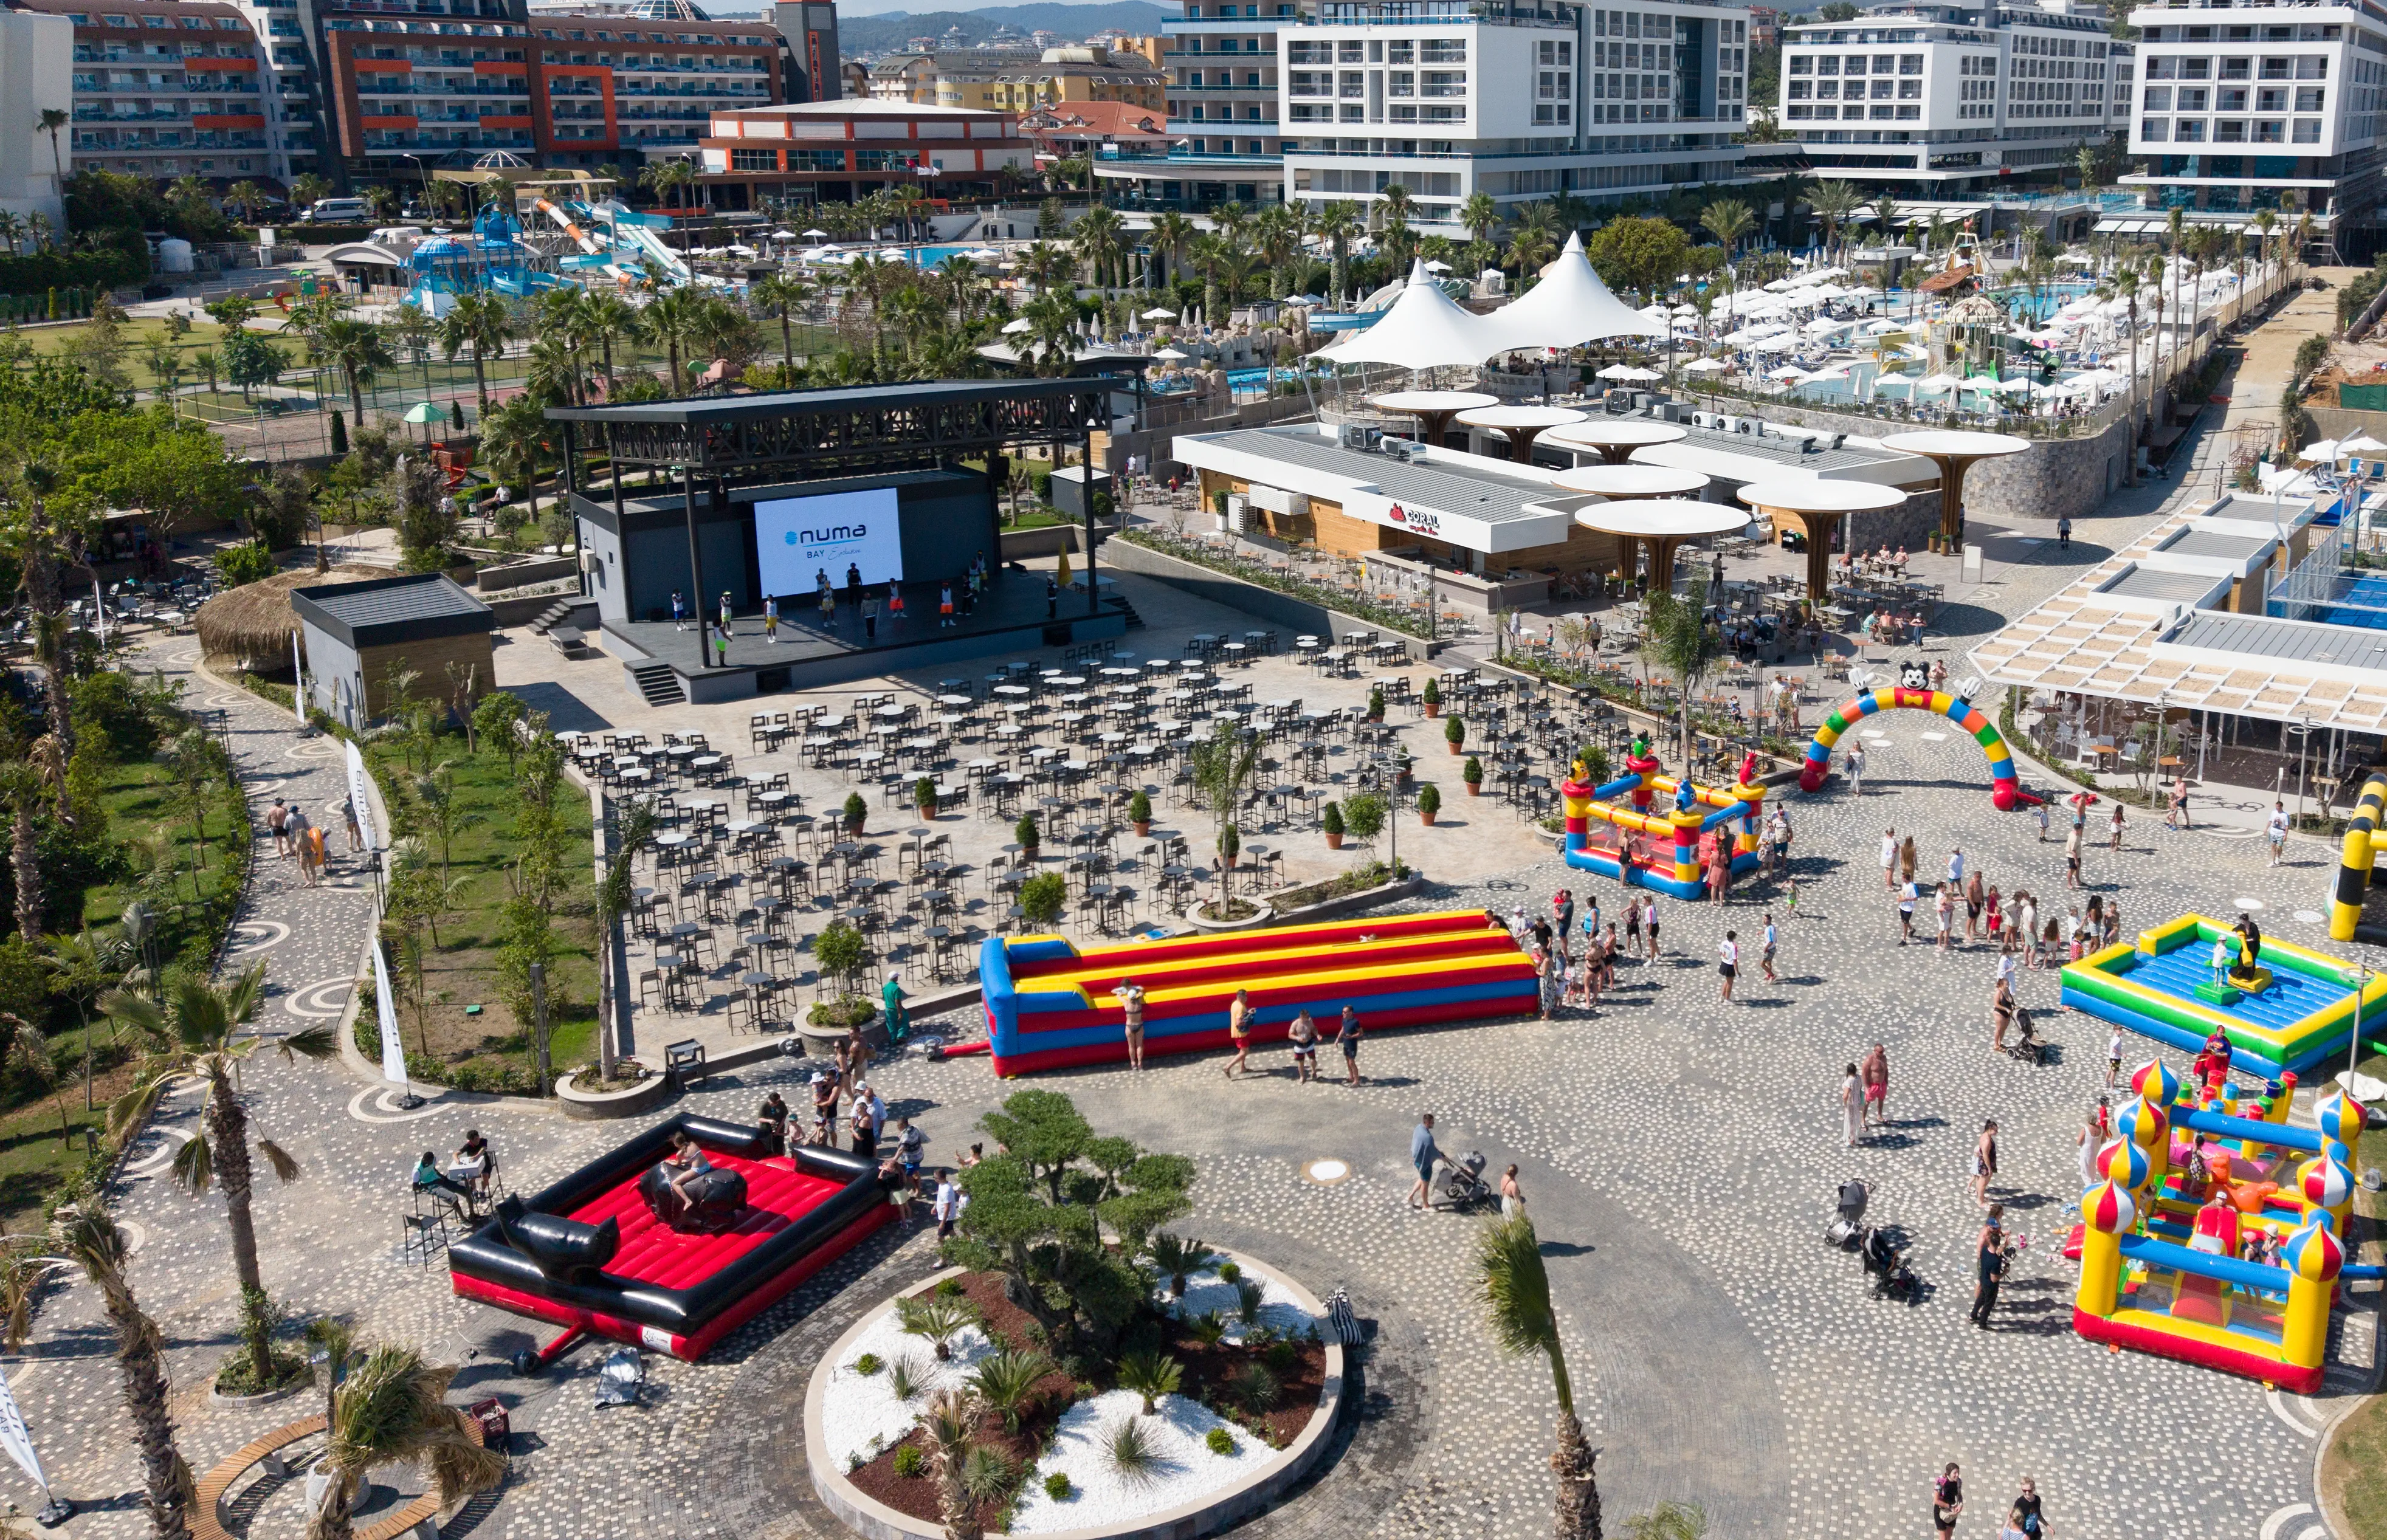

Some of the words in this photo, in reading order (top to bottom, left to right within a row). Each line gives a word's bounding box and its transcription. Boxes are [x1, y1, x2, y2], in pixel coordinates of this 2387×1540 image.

[1407, 509, 1439, 528] CORAL
[800, 524, 866, 544] numa
[807, 549, 825, 559] BAY
